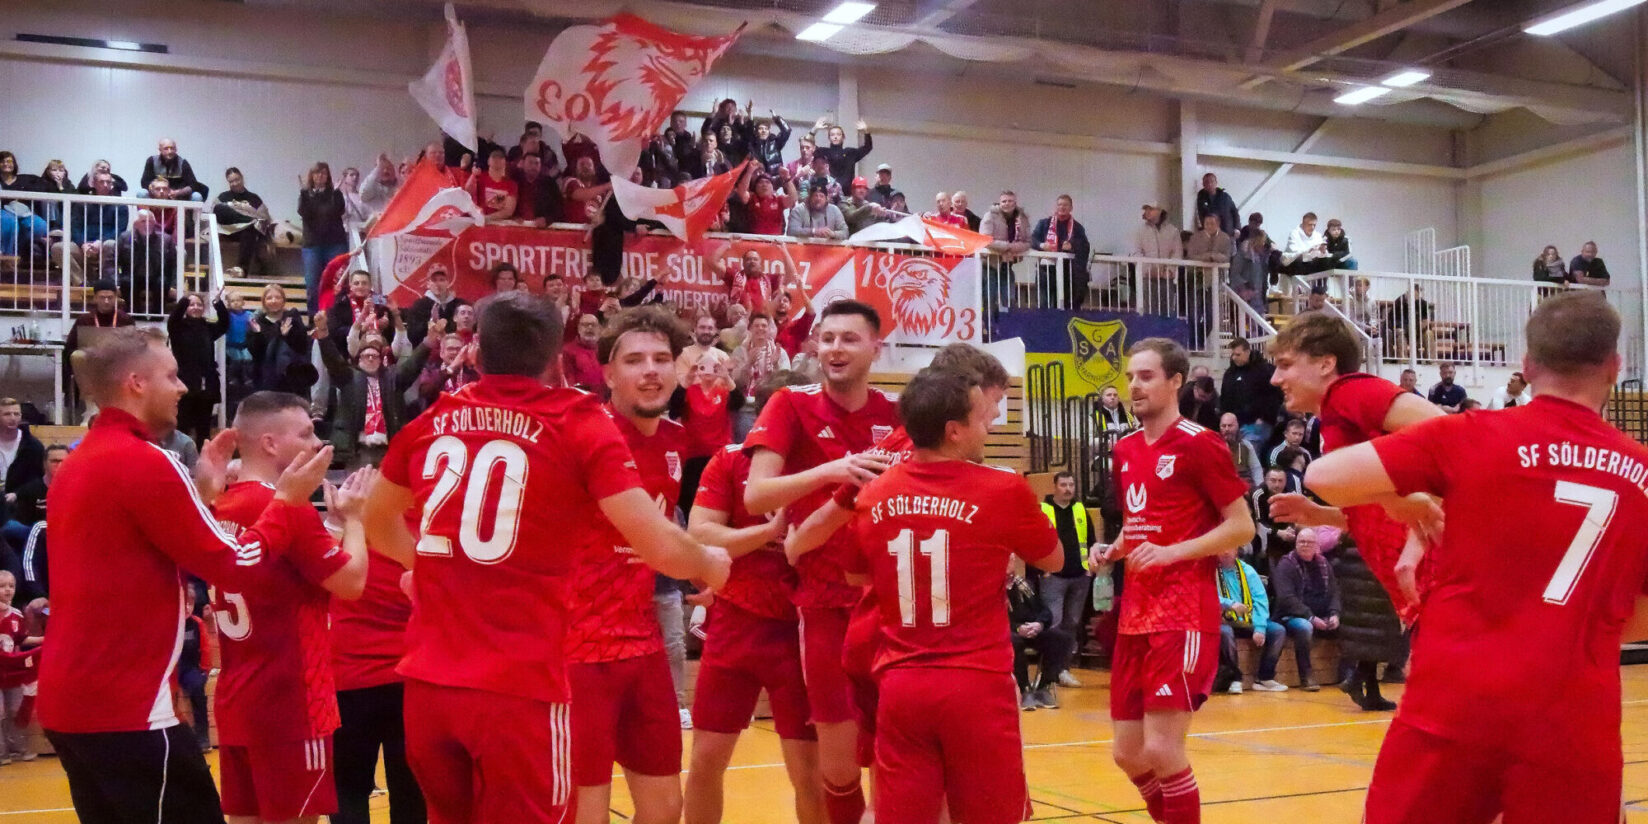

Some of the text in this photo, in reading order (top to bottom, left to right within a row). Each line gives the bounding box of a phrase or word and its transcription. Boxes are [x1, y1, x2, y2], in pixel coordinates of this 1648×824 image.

[938, 305, 977, 341] 93
[433, 406, 545, 444] SF SÖLDERHOLZ
[1517, 443, 1540, 468] SF
[416, 435, 529, 566] 20
[871, 494, 980, 525] SF SÖLDERHOLZ
[1541, 480, 1619, 606] 7
[887, 528, 951, 628] 11
